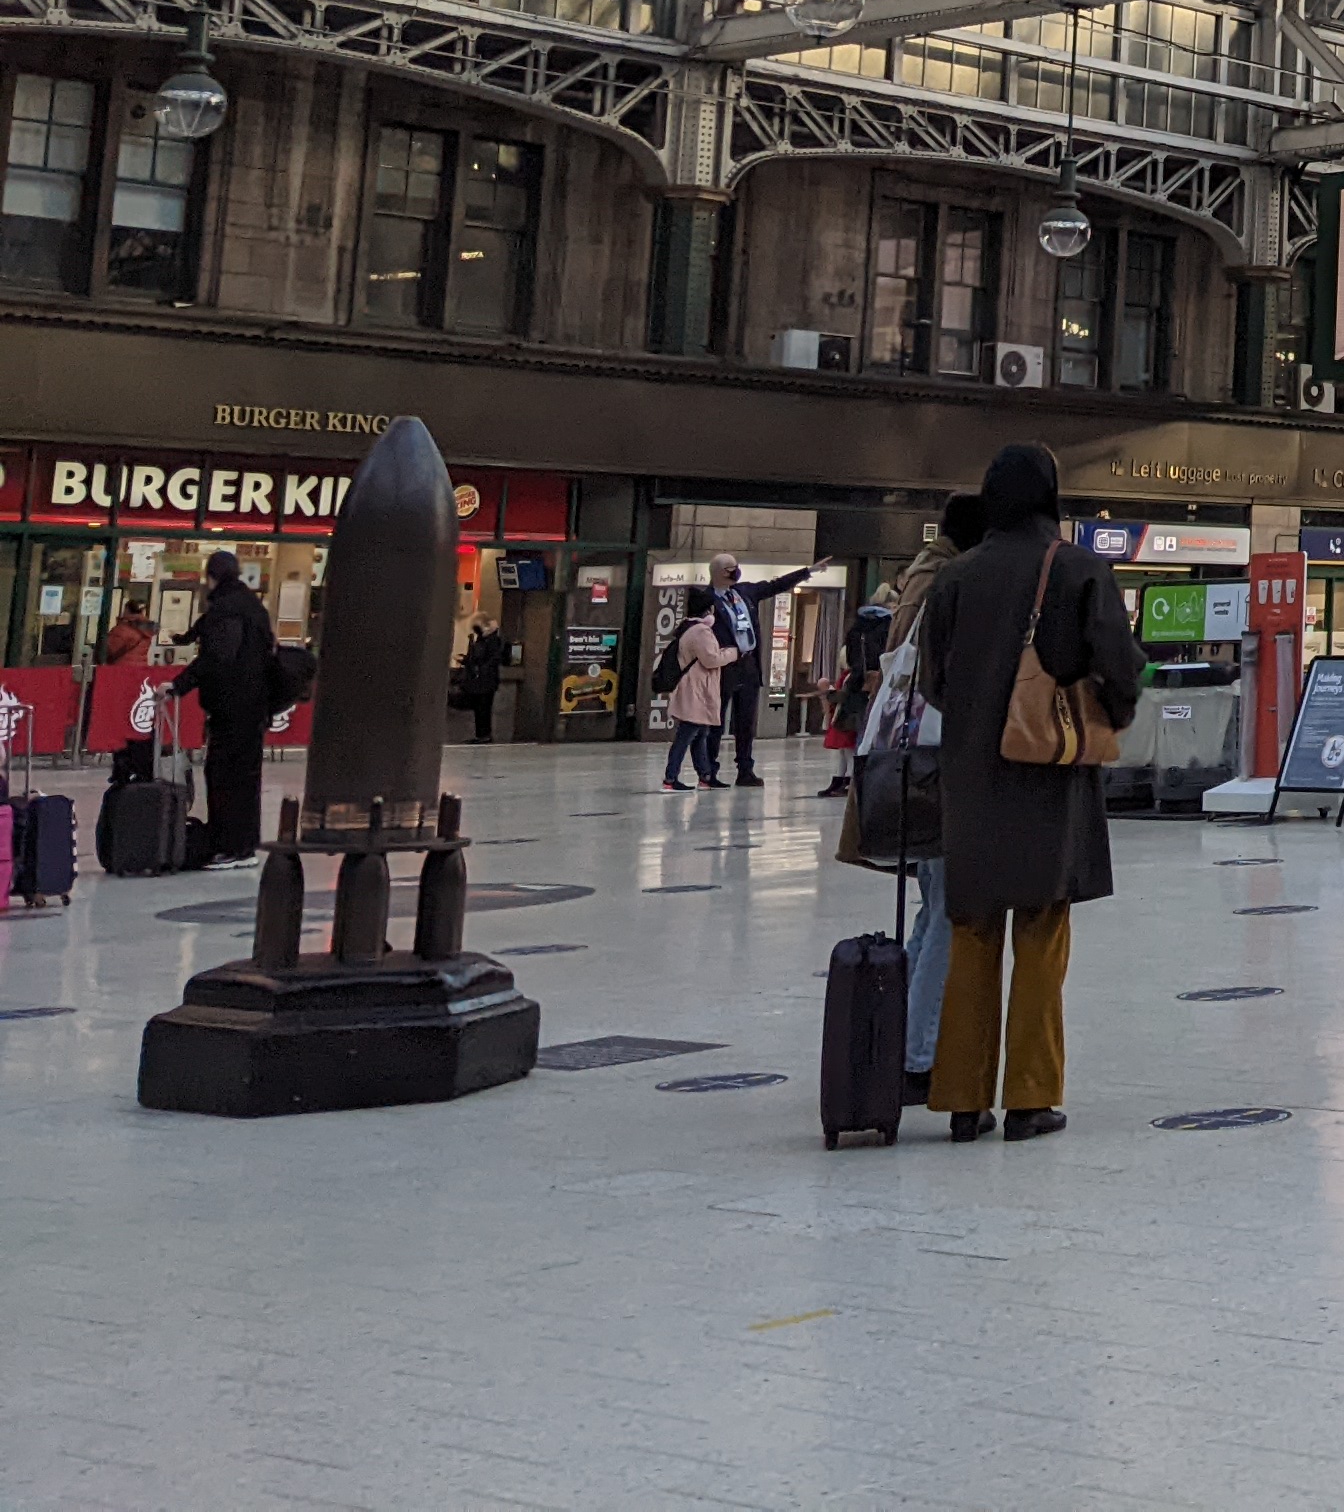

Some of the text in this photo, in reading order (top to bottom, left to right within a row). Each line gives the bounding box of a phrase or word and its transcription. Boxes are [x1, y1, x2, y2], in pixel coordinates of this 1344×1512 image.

[214, 405, 389, 434] BURGER KING
[1132, 460, 1161, 478] Left
[1164, 462, 1221, 484] luggage
[51, 461, 274, 516] BURGER
[1312, 683, 1343, 694] journeys
[1316, 673, 1343, 683] Making
